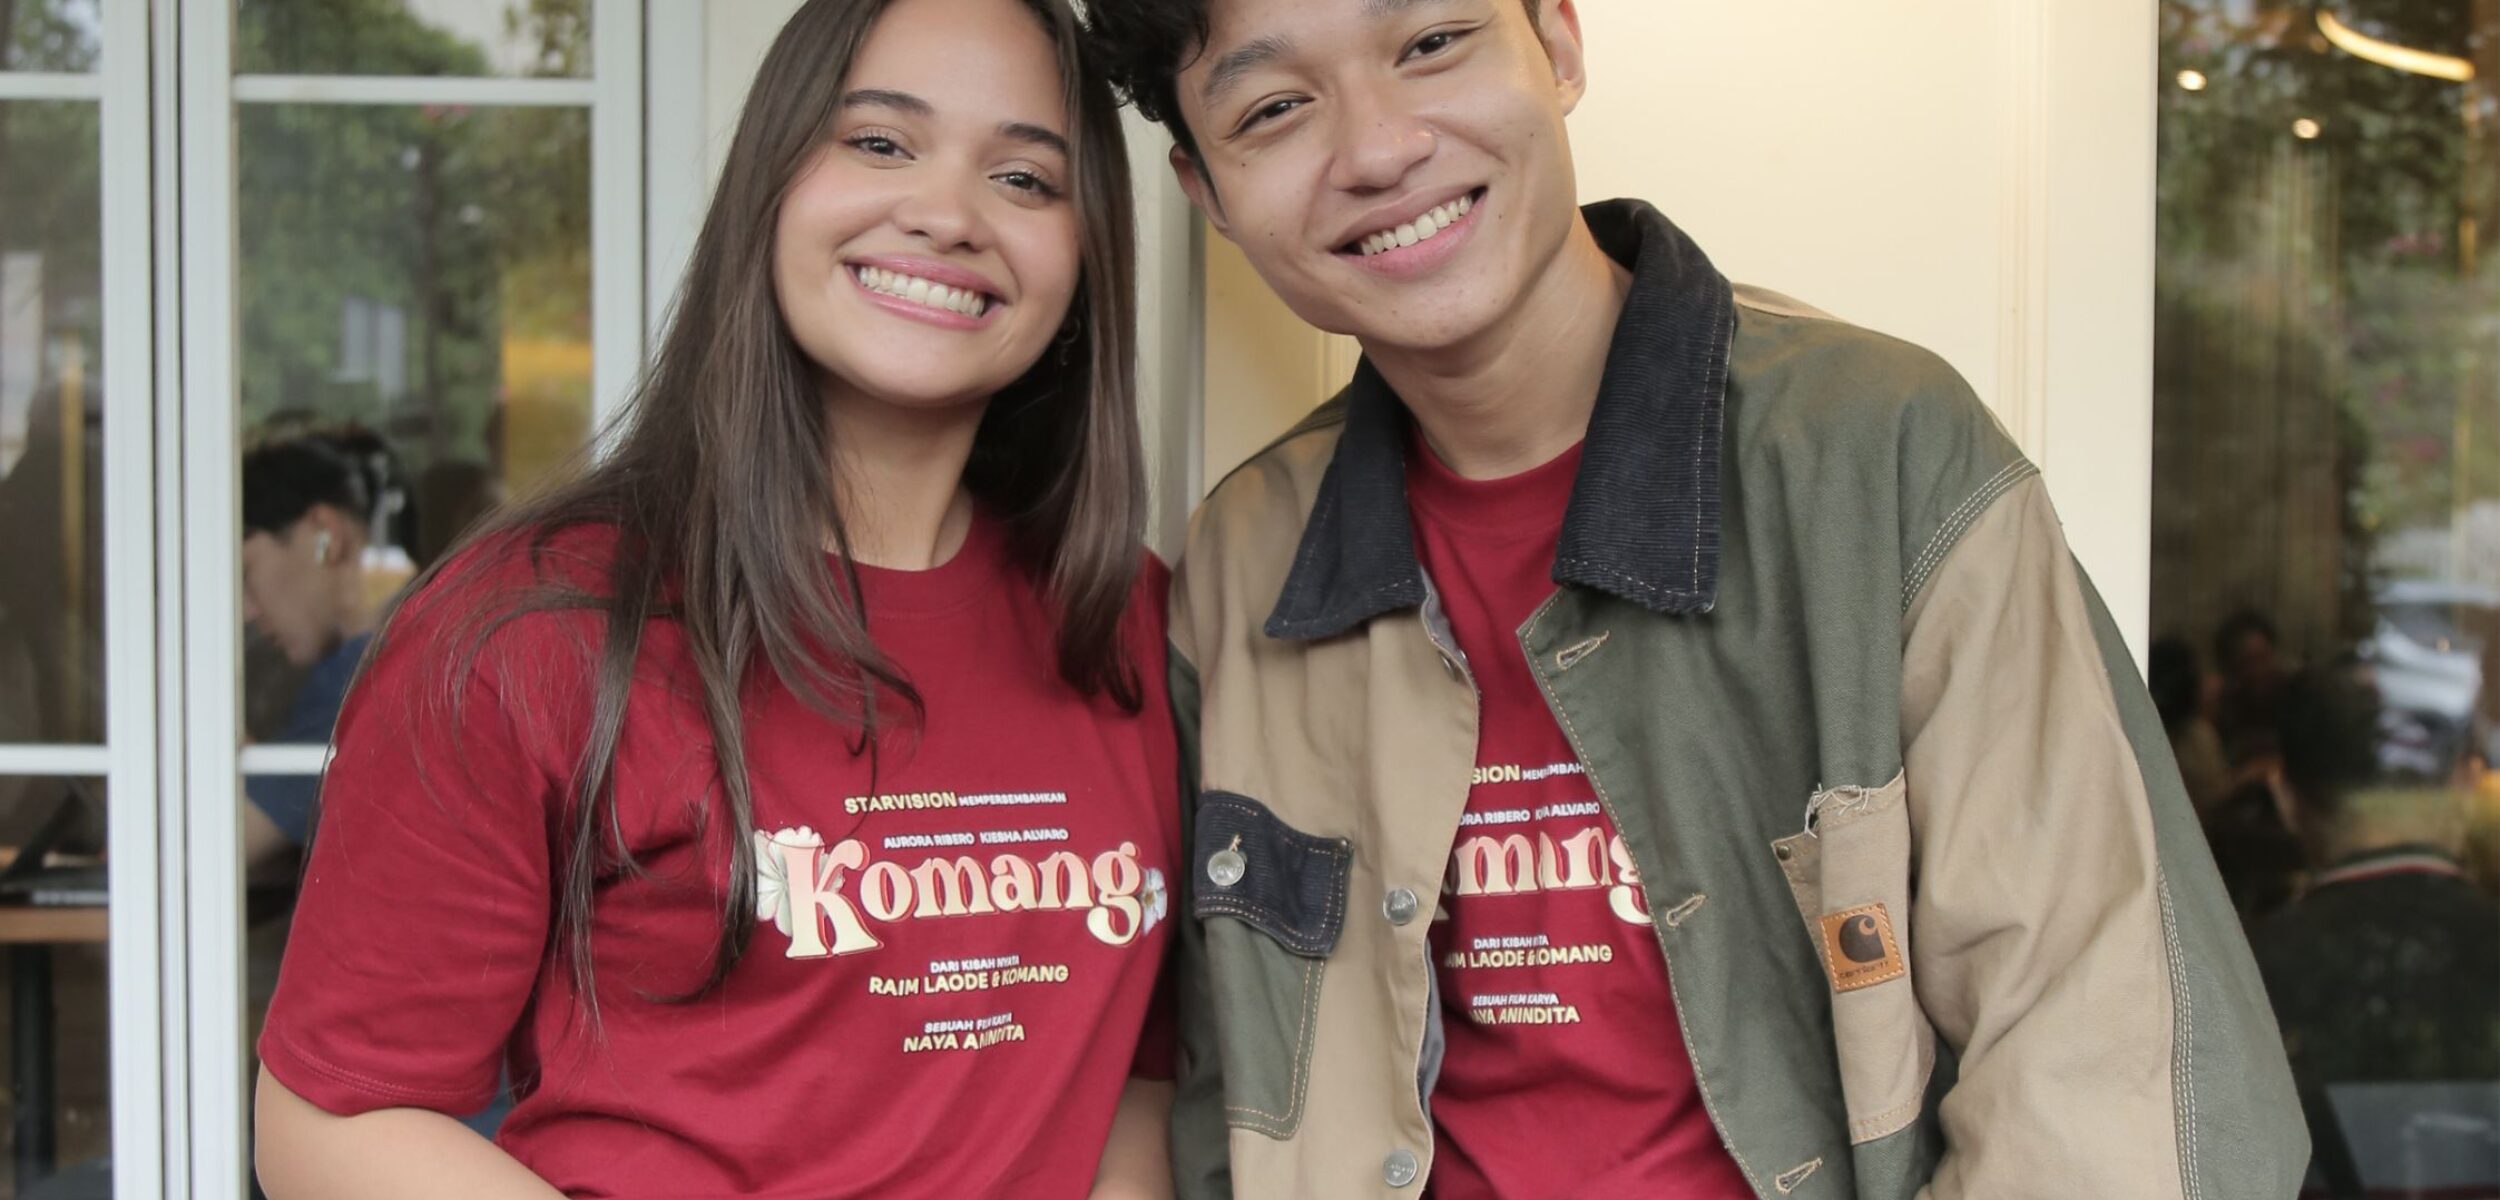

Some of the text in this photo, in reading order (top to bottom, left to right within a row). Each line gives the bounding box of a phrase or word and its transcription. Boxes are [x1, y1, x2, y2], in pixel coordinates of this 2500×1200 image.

[844, 791, 1067, 815] STARVISION MEMPERSEMBAHKAN
[1485, 809, 1531, 825] RIBERO
[1550, 802, 1601, 817] ALVARO
[883, 828, 1069, 849] AURORA RIBERO KIESHA ALVARO
[785, 839, 1142, 959] Komang
[1473, 938, 1501, 950] DARI
[930, 960, 959, 974] DARI
[1470, 948, 1526, 969] LAODE
[868, 976, 920, 997] RAIM
[923, 969, 989, 994] LAODE
[1001, 963, 1069, 986] KOMANG
[1498, 1006, 1582, 1024] ANINDITA
[924, 1019, 974, 1034] SEBUAH
[903, 1030, 959, 1053] NAYA
